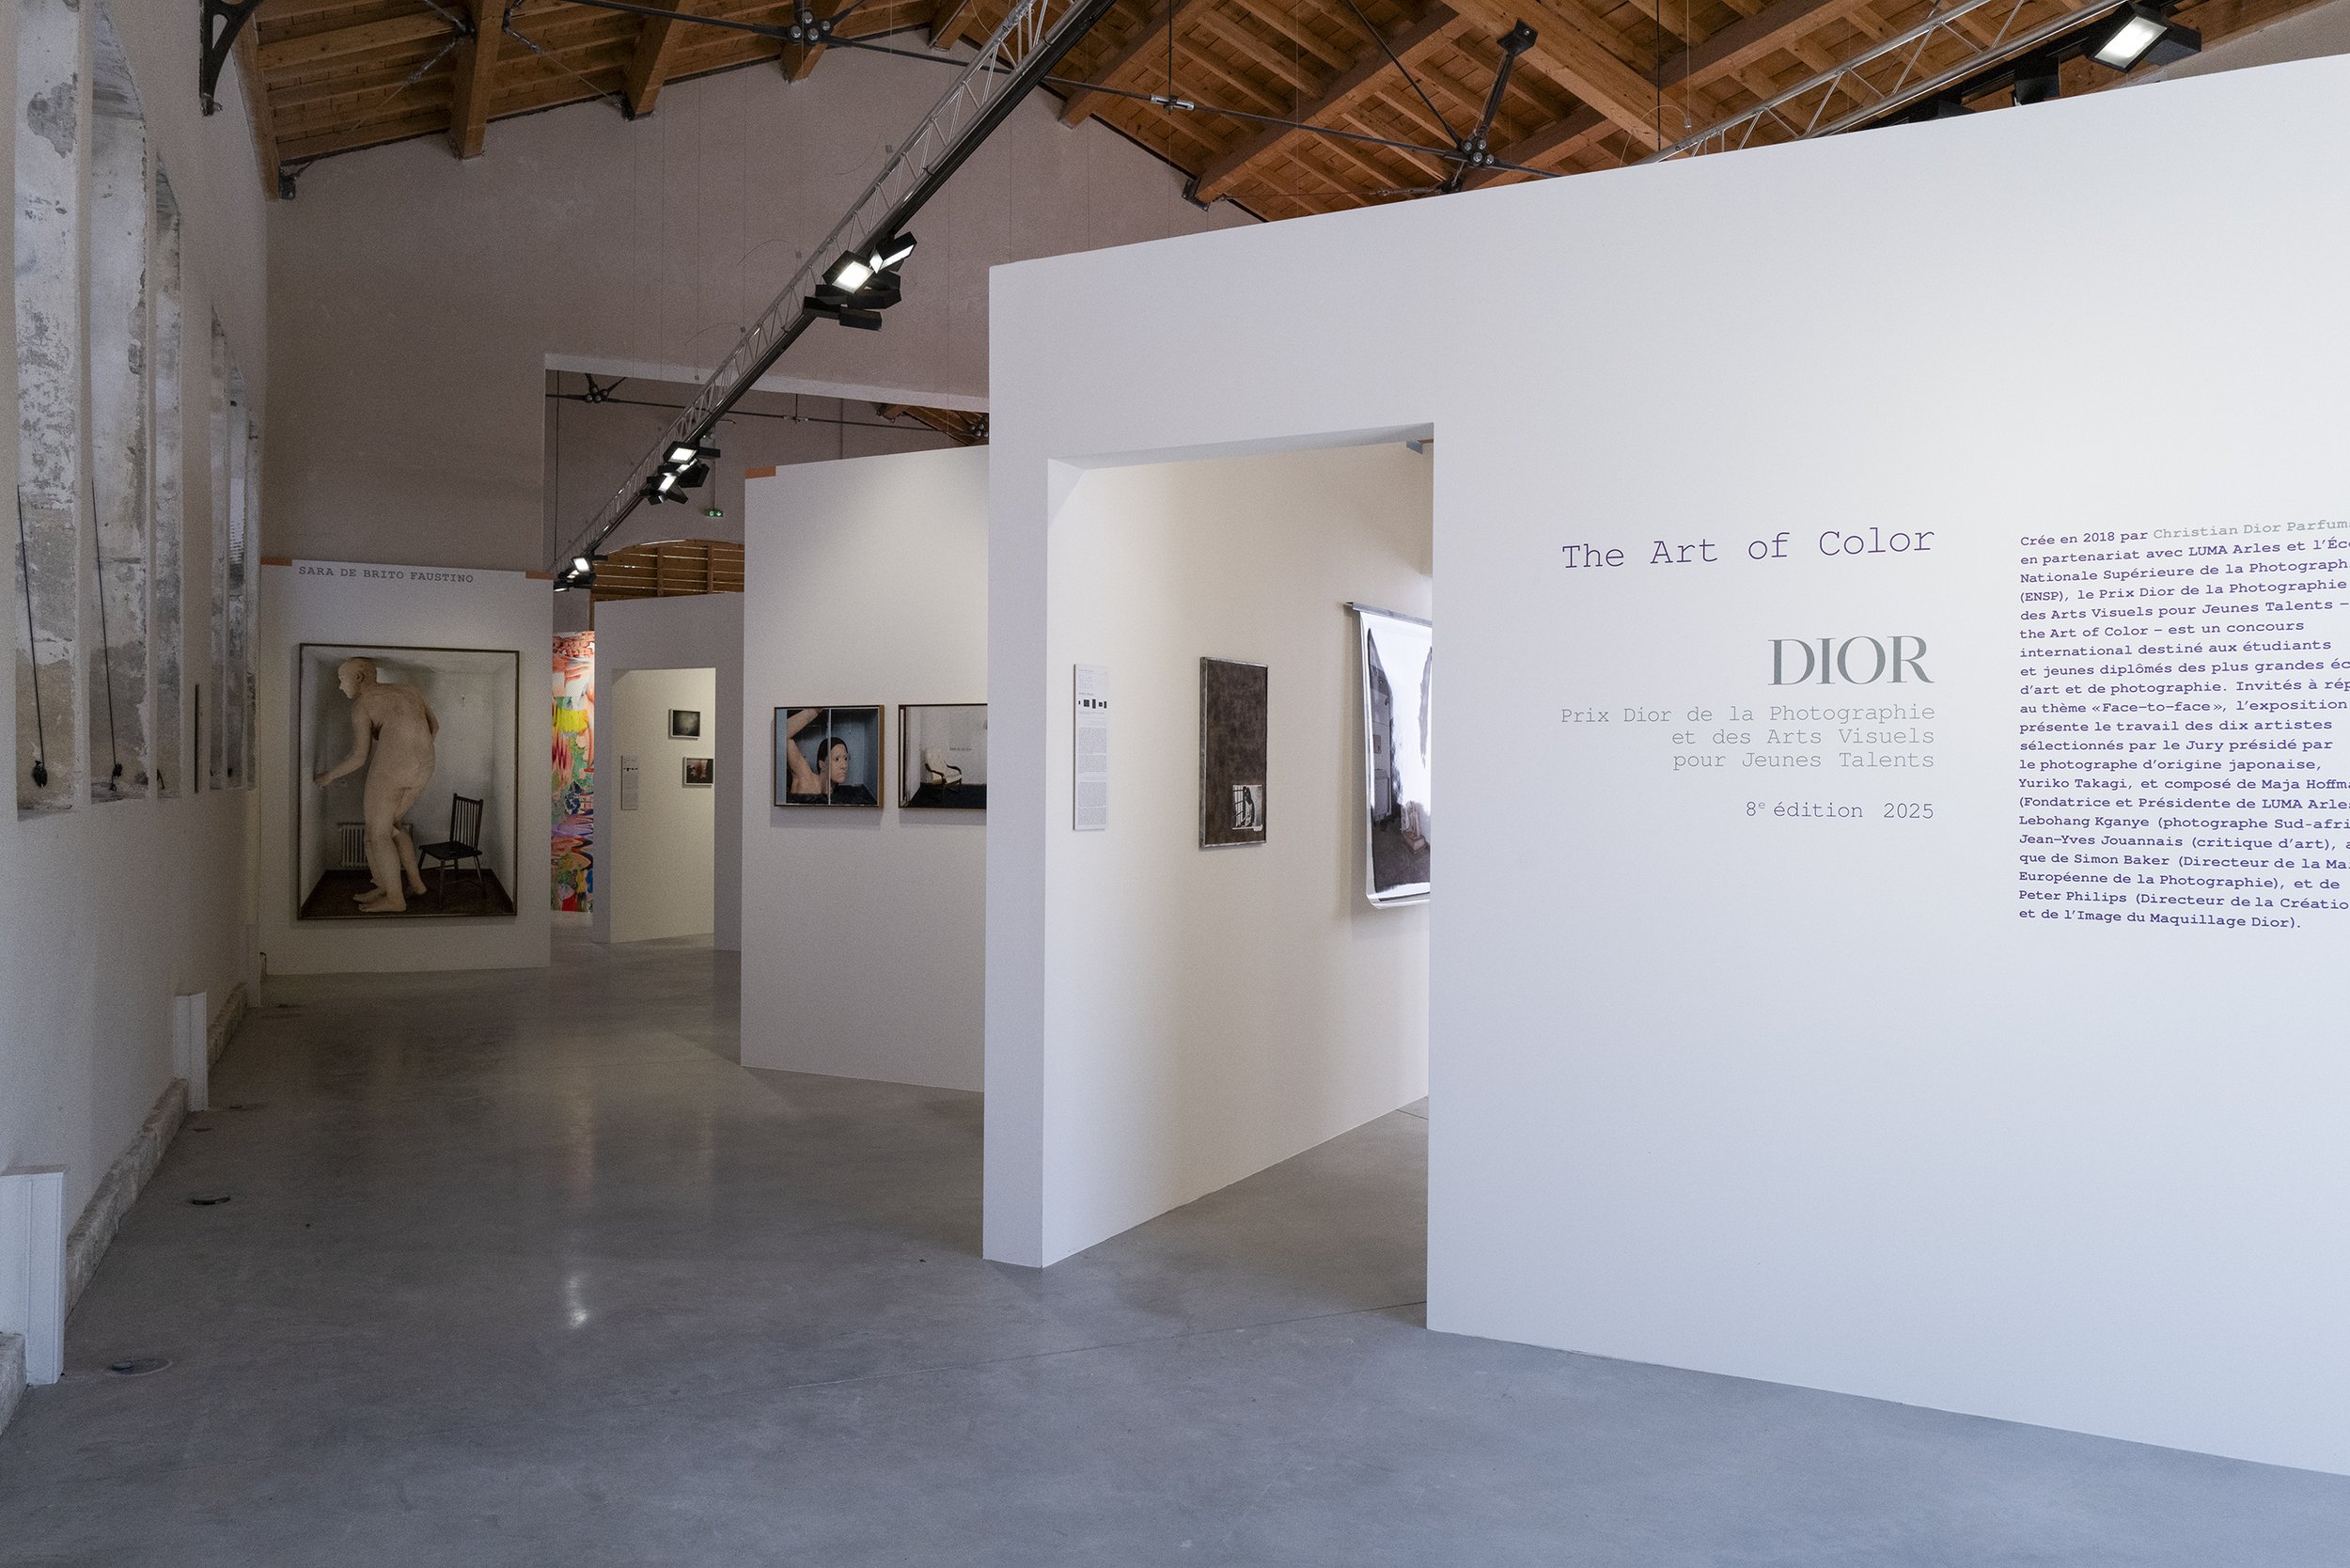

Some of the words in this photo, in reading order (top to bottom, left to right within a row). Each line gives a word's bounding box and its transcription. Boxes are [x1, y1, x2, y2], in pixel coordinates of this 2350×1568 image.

[2021, 535, 2055, 545] Crée
[2083, 532, 2115, 542] 2018
[2121, 532, 2148, 543] par
[2154, 526, 2238, 539] Christian
[2244, 524, 2281, 533] Dior
[1562, 543, 1623, 568] The
[1650, 539, 1717, 564] Art
[1748, 532, 1790, 559] of
[1820, 527, 1935, 556] Color
[2043, 550, 2139, 566] partenariat
[2146, 550, 2183, 558] avec
[2188, 545, 2228, 556] LUMA
[2232, 543, 2280, 554] Arles
[2287, 541, 2306, 551] et
[2313, 536, 2350, 550] l'Éc
[299, 567, 334, 575] SARA
[340, 568, 356, 576] DE
[364, 570, 404, 579] BRITO
[410, 572, 473, 583] FAUSTINO
[2020, 572, 2097, 583] Nationale
[2104, 568, 2194, 581] Supérieure
[2200, 565, 2218, 574] de
[2226, 564, 2244, 573] la
[2249, 558, 2350, 573] Photograph
[2021, 591, 2068, 604] (ENSP),
[2077, 590, 2093, 599] le
[2099, 588, 2134, 598] Prix
[2139, 587, 2175, 597] Dior
[2181, 586, 2199, 595] de
[2206, 585, 2223, 594] la
[2230, 579, 2346, 594] Photographie
[2021, 611, 2045, 619] des
[2051, 610, 2086, 619] Arts
[2092, 606, 2153, 617] Visuels
[2158, 607, 2196, 618] pour
[2202, 604, 2259, 614] Jeunes
[2265, 601, 2332, 611] Talents
[2019, 630, 2044, 638] the
[2050, 629, 2076, 637] Art
[2083, 627, 2099, 636] of
[2105, 626, 2148, 635] Color
[2169, 625, 2195, 635] est
[2227, 623, 2304, 633] concours
[2020, 645, 2132, 657] international
[2138, 642, 2202, 654] destiné
[2243, 640, 2331, 651] étudiants
[1767, 635, 1935, 685] DIOR
[2021, 667, 2036, 676] et
[2044, 666, 2094, 678] jeunes
[2100, 663, 2171, 676] diplômés
[2178, 663, 2205, 672] des
[2212, 662, 2248, 674] plus
[2255, 660, 2324, 673] grandes
[2020, 685, 2060, 695] d'art
[2065, 685, 2082, 694] et
[2088, 684, 2106, 693] de
[2110, 682, 2226, 696] photographie.
[2236, 680, 2301, 691] Invités
[2309, 679, 2318, 689] à
[1561, 708, 1608, 722] Prix
[1624, 707, 1671, 722] Dior
[1687, 707, 1712, 721] de
[1730, 706, 1754, 721] la
[1770, 703, 1935, 724] Photographie
[2042, 702, 2086, 713] thème
[2236, 699, 2347, 713] l'exposition
[2020, 722, 2089, 734] présente
[2094, 722, 2111, 731] le
[2117, 721, 2179, 730] travail
[2186, 721, 2213, 730] des
[2219, 720, 2248, 729] dix
[2254, 719, 2332, 729] artistes
[1672, 730, 1696, 745] et
[1713, 729, 1750, 744] des
[1767, 729, 1821, 744] Arts
[1839, 728, 1934, 744] Visuels
[2020, 740, 2123, 750] sélectionnés
[2129, 743, 2156, 752] par
[2163, 741, 2180, 749] le
[2186, 741, 2224, 752] Jury
[2229, 739, 2296, 752] présidé
[2302, 742, 2333, 752] par
[1673, 756, 1726, 771] pour
[1743, 753, 1821, 767] Jeunes
[1840, 752, 1934, 767] Talents
[2019, 760, 2035, 769] le
[2040, 760, 2138, 772] photographe
[2143, 760, 2221, 772] d'origine
[2229, 760, 2321, 772] japonaise,
[2018, 778, 2069, 788] Yuriko
[2075, 778, 2132, 791] Takagi,
[2141, 779, 2158, 788] et
[2165, 778, 2231, 791] composé
[2237, 779, 2256, 789] de
[2262, 779, 2300, 792] Maja
[2306, 779, 2350, 789] Hoffm
[1774, 802, 1863, 818] édition
[1884, 803, 1934, 819] 2025
[2020, 797, 2110, 808] (Fondatrice
[2116, 798, 2133, 807] et
[2138, 797, 2231, 808] Présidente
[2236, 799, 2255, 808] de
[2262, 799, 2303, 808] LUMA
[2308, 799, 2350, 809] Arle
[2019, 816, 2090, 828] Lebohang
[2095, 817, 2149, 829] Kganye
[2158, 817, 2267, 830] (photographe
[2101, 836, 2183, 846] Jouannais
[2192, 838, 2272, 850] (critique
[2279, 839, 2335, 851] d'art),
[2020, 855, 2045, 864] que
[2051, 854, 2068, 863] de
[2075, 854, 2119, 864] Simon
[2123, 855, 2170, 865] Baker
[2179, 856, 2269, 868] (Directeur
[2274, 858, 2295, 868] de
[2302, 858, 2320, 869] la
[2019, 871, 2107, 884] Européenne
[2113, 873, 2131, 884] de
[2138, 874, 2154, 884] la
[2160, 875, 2283, 889] Photographie),
[2294, 880, 2312, 888] et
[2320, 879, 2340, 888] de
[2019, 890, 2061, 900] Peter
[2066, 891, 2126, 904] Philips
[2137, 893, 2225, 905] (Directeur
[2231, 897, 2250, 906] de
[2255, 897, 2274, 907] la
[2019, 909, 2035, 917] et
[2042, 909, 2059, 918] de
[2064, 910, 2122, 923] l'Image
[2127, 912, 2145, 922] du
[2150, 914, 2246, 929] Maquillage
[2251, 917, 2300, 928] Dior).
